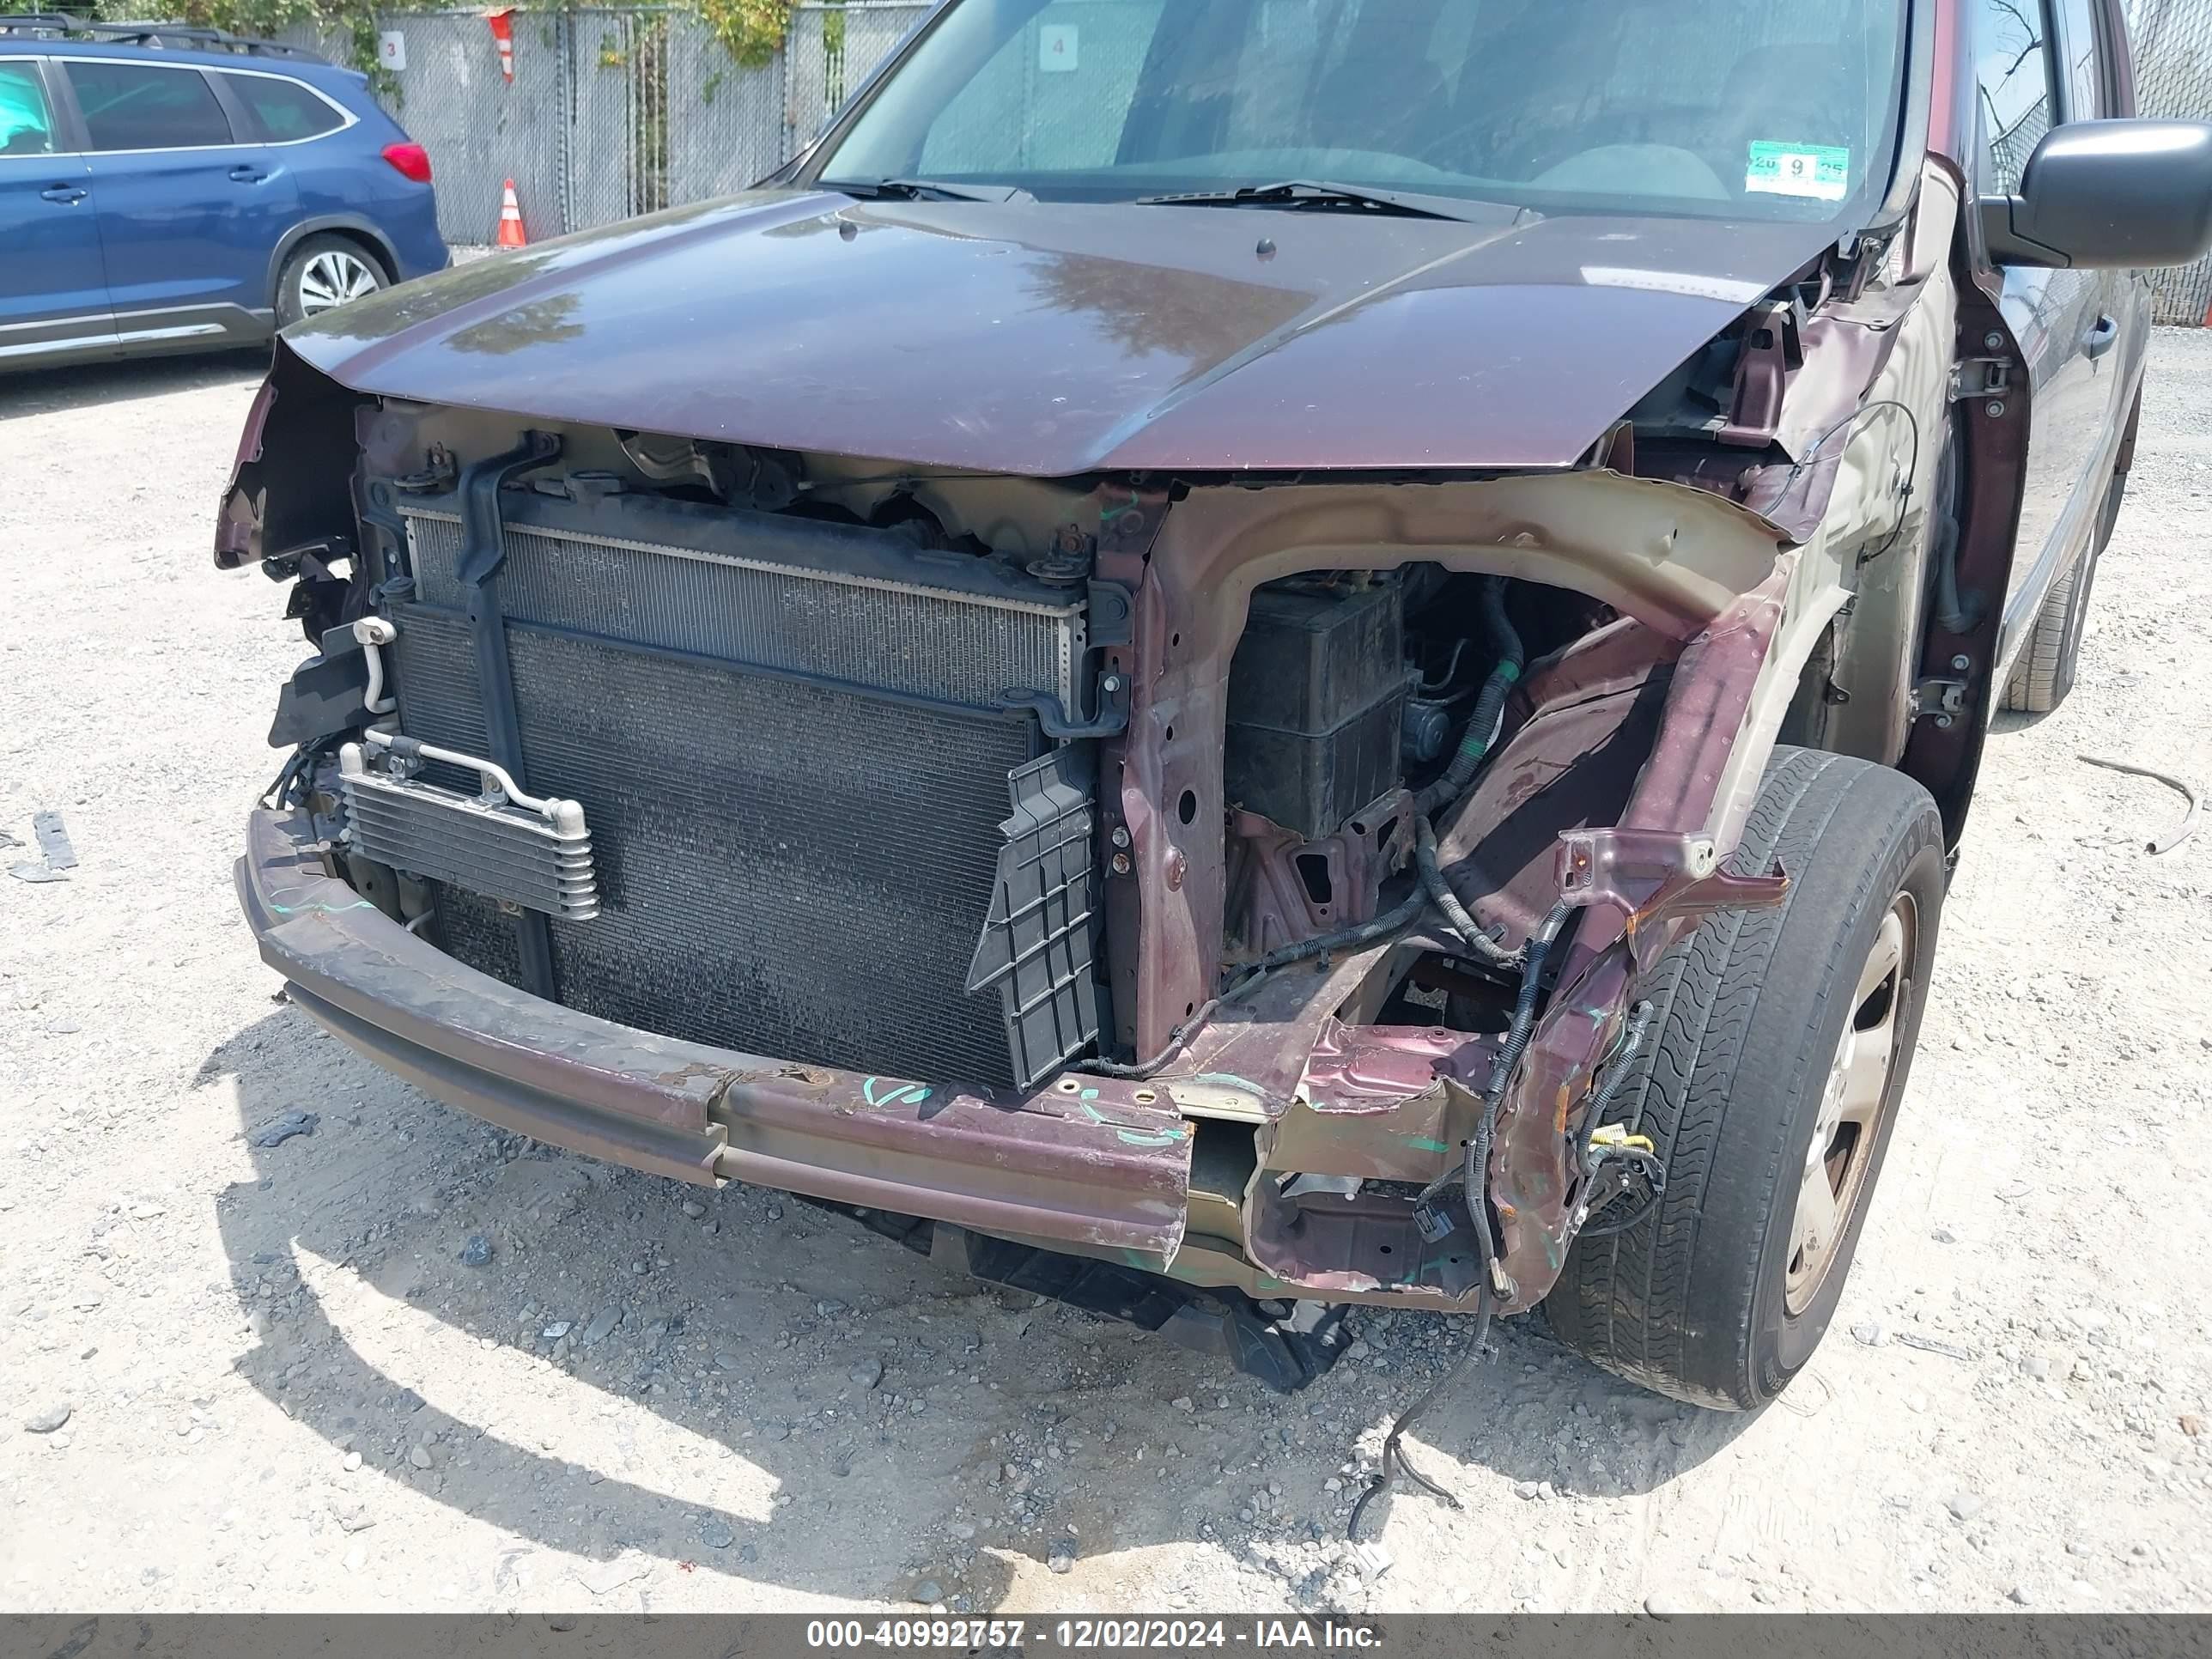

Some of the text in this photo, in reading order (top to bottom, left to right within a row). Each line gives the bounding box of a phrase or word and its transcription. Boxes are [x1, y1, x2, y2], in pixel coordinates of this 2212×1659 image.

[387, 42, 396, 57] 3
[1053, 38, 1064, 55] 4
[1791, 159, 1803, 175] 9
